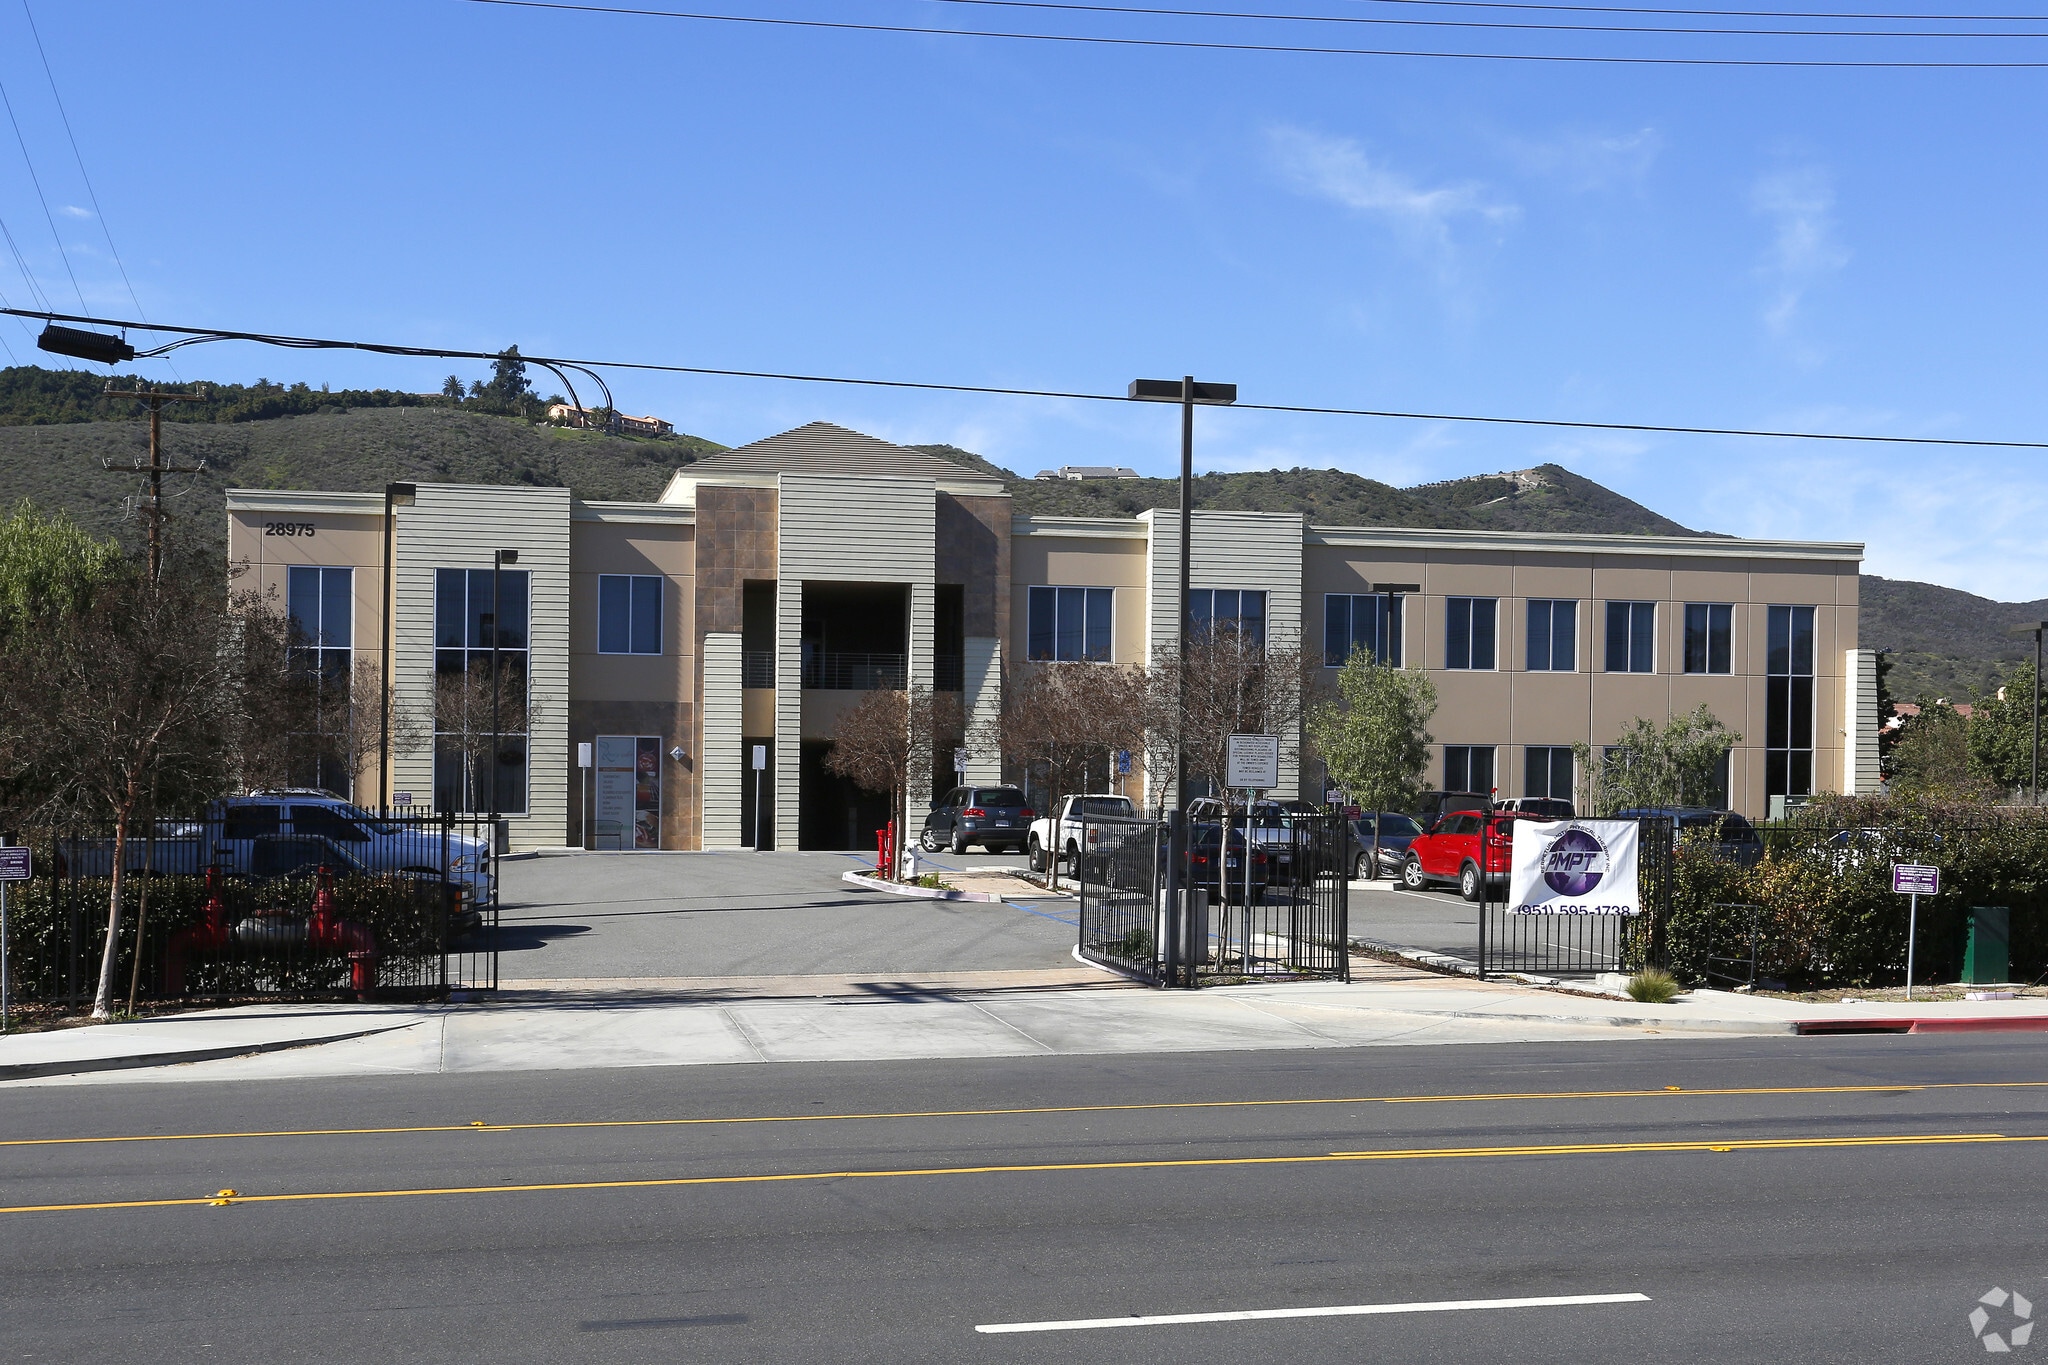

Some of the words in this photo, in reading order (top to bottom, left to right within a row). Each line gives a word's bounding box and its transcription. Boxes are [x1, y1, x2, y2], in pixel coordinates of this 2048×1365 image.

[265, 522, 316, 537] 28975
[1597, 836, 1611, 861] THERAPY
[1545, 852, 1597, 871] PMPT
[1517, 904, 1553, 915] (951)
[1560, 905, 1630, 915] 595-1738
